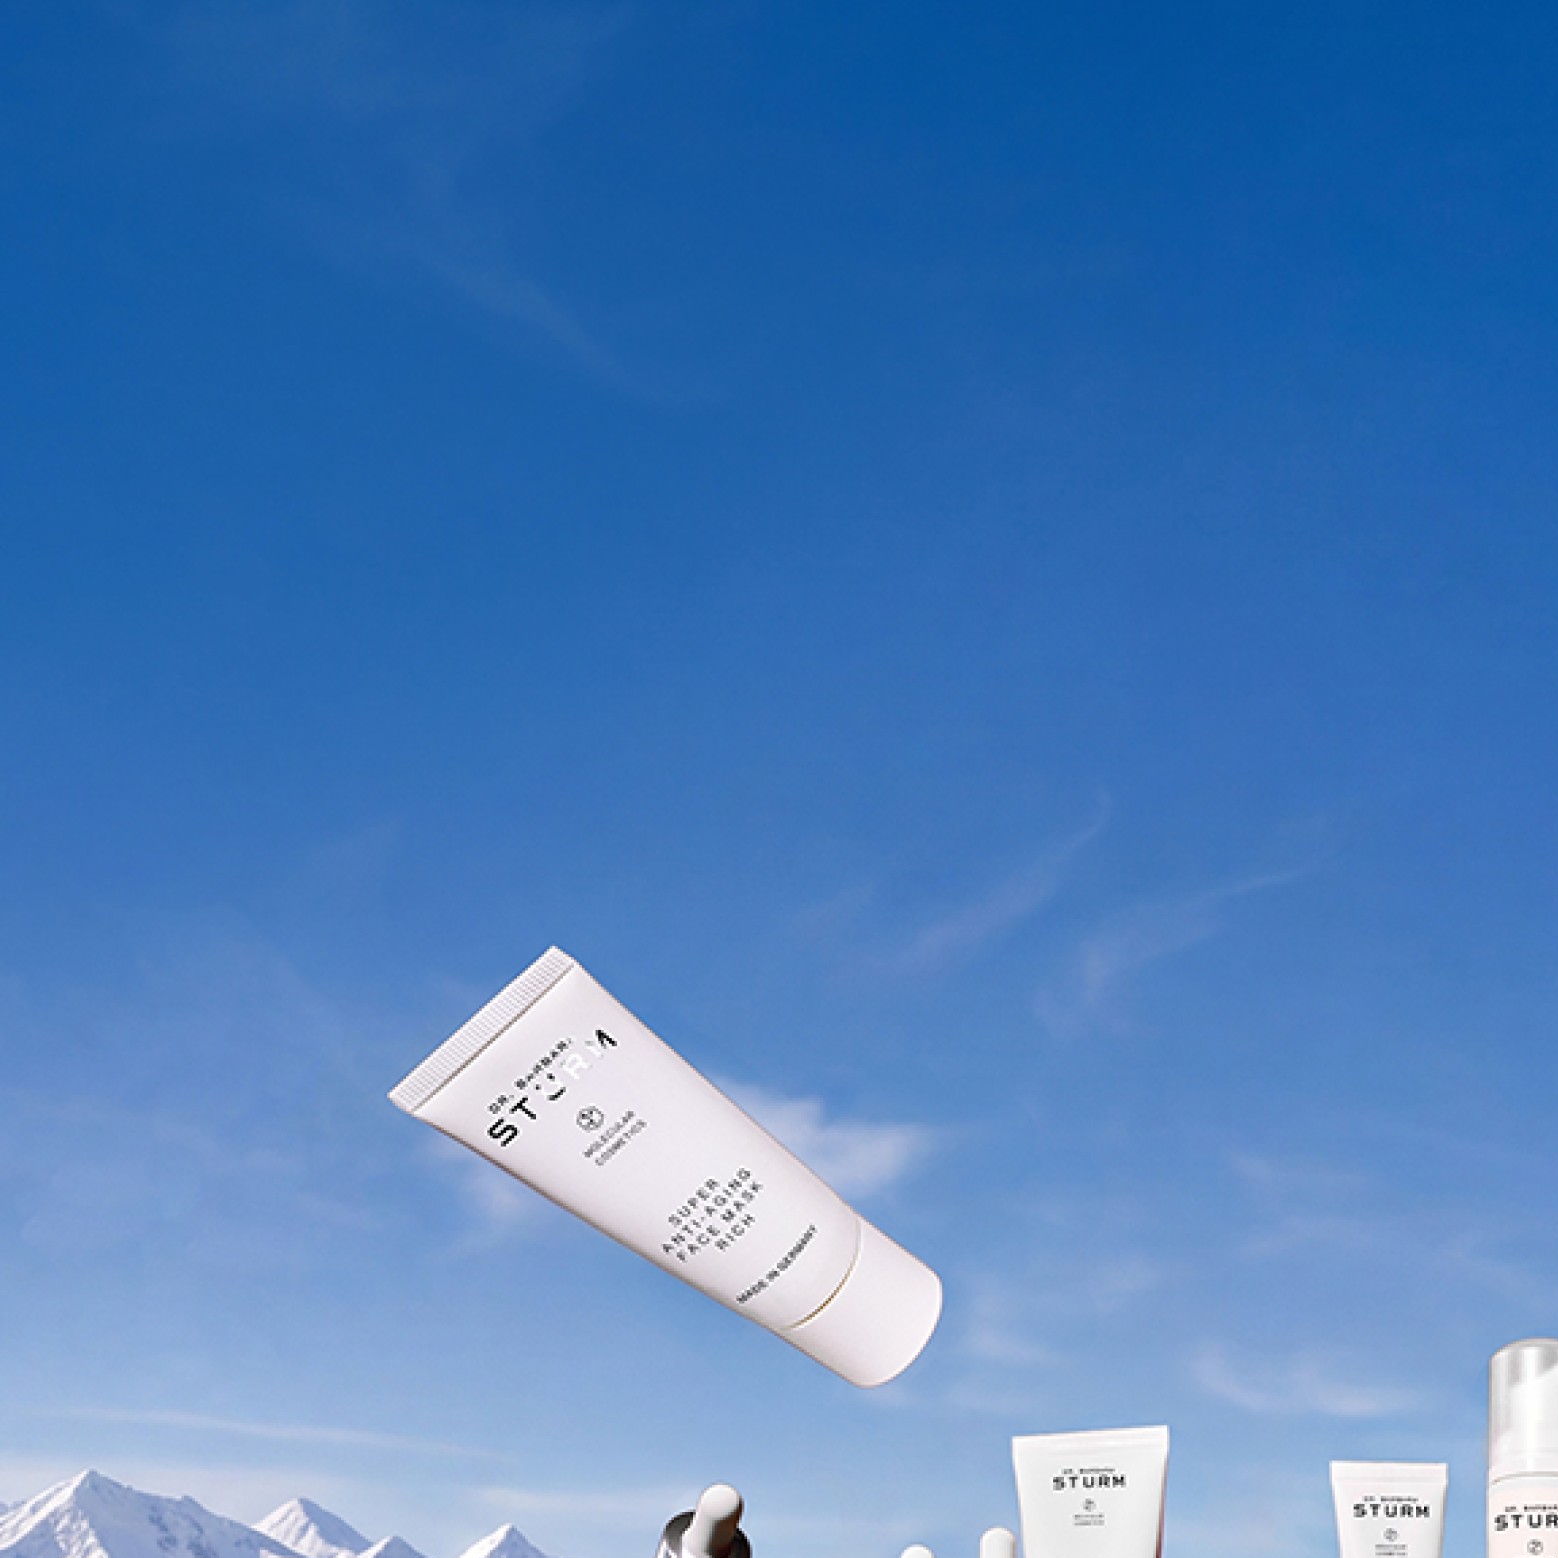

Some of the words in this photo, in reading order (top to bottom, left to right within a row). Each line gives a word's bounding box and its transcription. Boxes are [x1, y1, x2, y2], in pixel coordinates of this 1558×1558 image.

[661, 1167, 751, 1253] ANTI-AGING
[668, 1178, 719, 1227] SUPER
[676, 1224, 720, 1263] FACE
[720, 1180, 764, 1222] MASK
[715, 1213, 756, 1252] RICH
[1052, 1475, 1127, 1491] STURM
[1353, 1504, 1430, 1518] STURM
